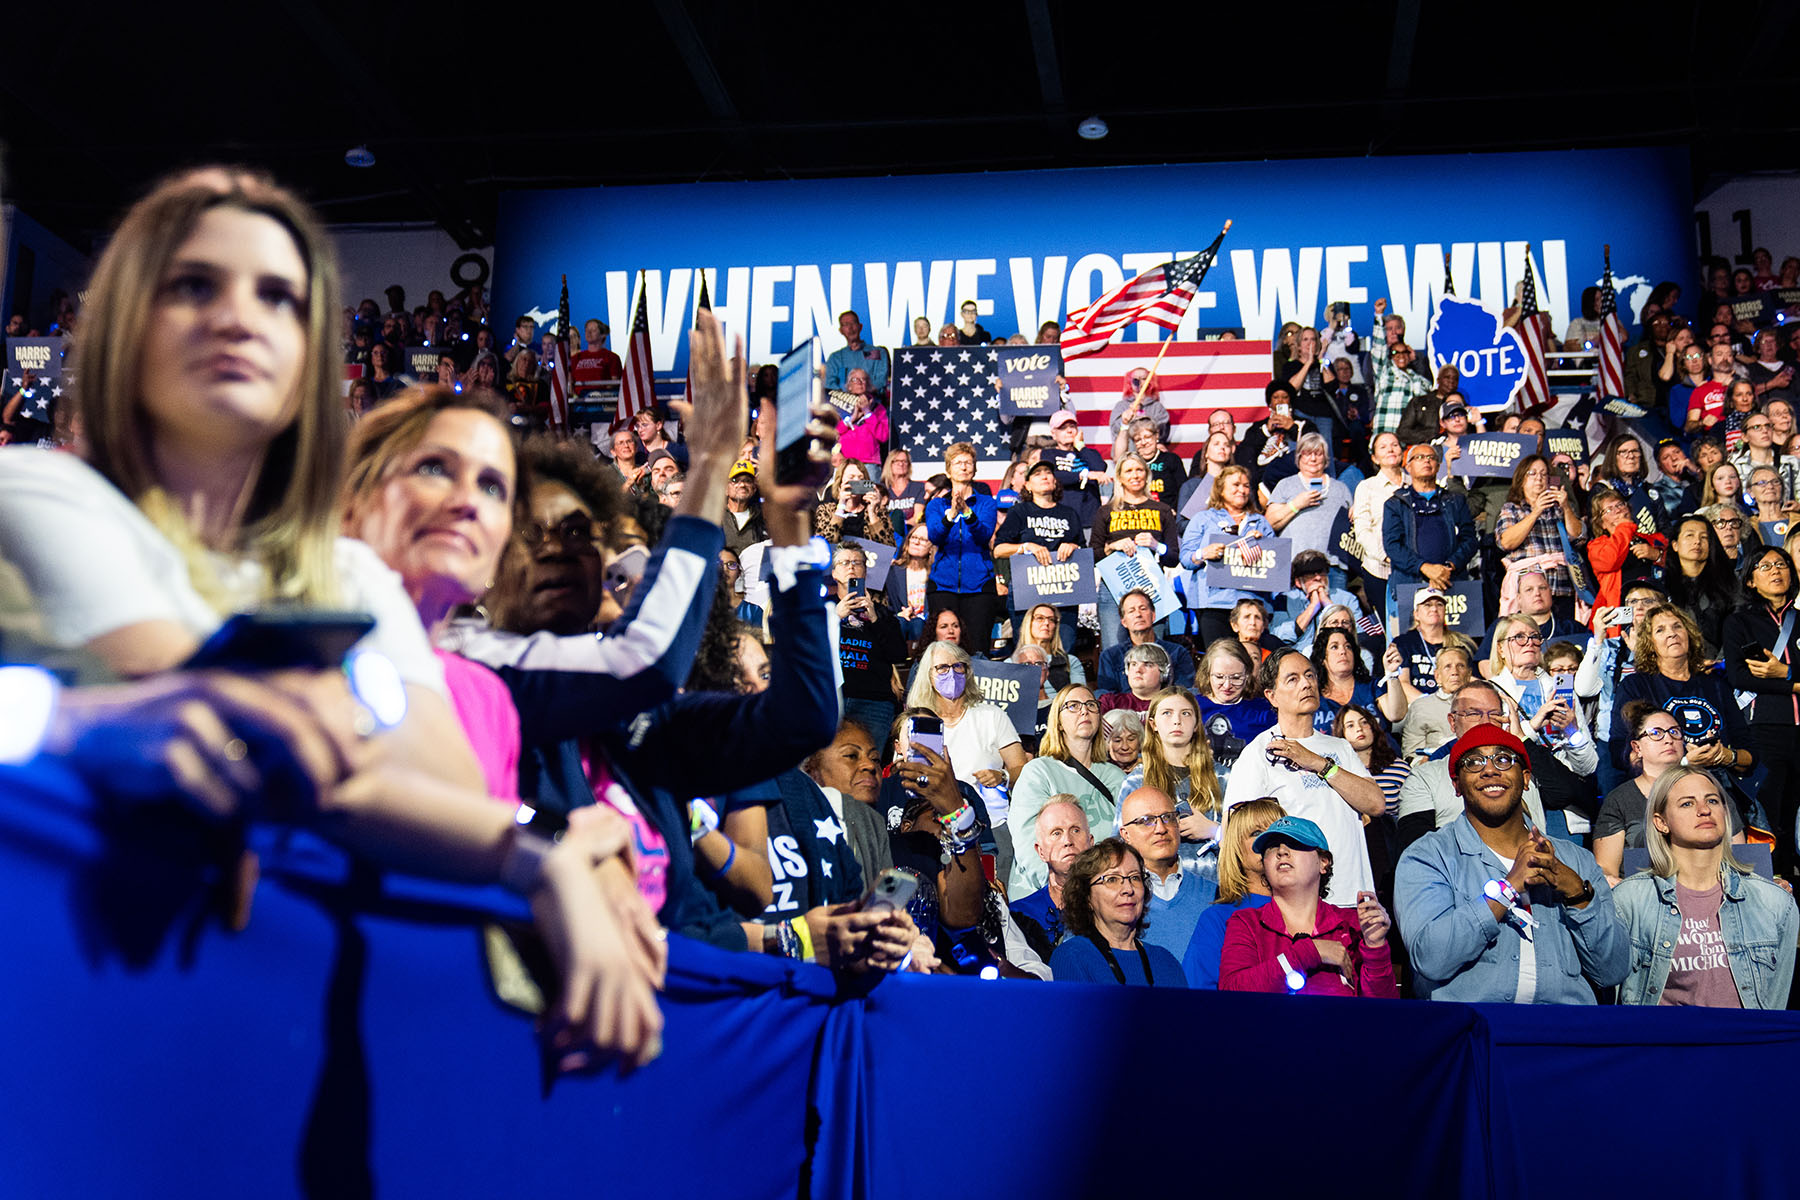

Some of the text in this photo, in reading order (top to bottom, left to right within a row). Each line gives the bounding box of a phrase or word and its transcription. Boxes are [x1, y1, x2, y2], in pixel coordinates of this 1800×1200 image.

[605, 262, 853, 372] WHEN
[864, 258, 996, 347] WE
[1230, 246, 1369, 350] WE
[1381, 240, 1570, 350] WIN
[15, 346, 51, 361] HARRIS
[20, 360, 45, 369] WALZ
[1005, 353, 1051, 373] vote
[1010, 385, 1049, 401] HARRIS
[1016, 400, 1044, 409] WALZ
[1468, 440, 1521, 459] HARRIS
[1548, 438, 1583, 453] HARRIS
[1475, 455, 1512, 467] WALZ
[886, 497, 915, 510] ARRIS
[1110, 508, 1160, 520] WESTERN
[1027, 516, 1070, 531] HARRIS
[1109, 519, 1162, 533] MICHIGAN
[1034, 528, 1065, 538] WALZ
[1027, 563, 1080, 585] HARRIS
[1116, 562, 1136, 590] VOTES
[1231, 565, 1268, 579] WALZ
[1036, 582, 1074, 595] WALZ
[1685, 917, 1710, 931] that
